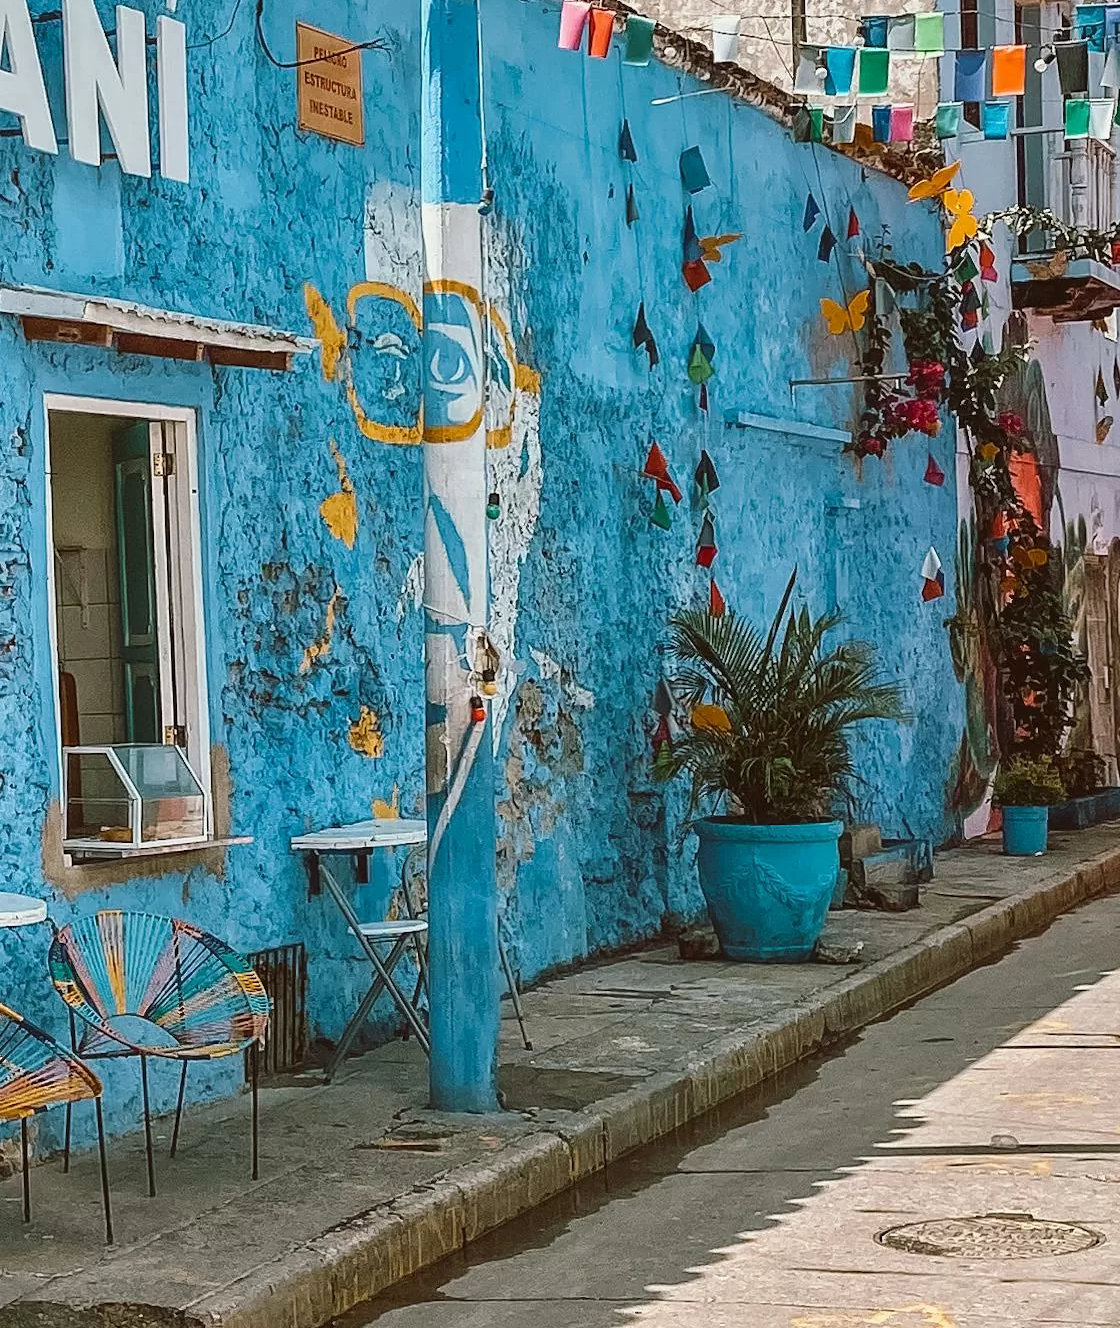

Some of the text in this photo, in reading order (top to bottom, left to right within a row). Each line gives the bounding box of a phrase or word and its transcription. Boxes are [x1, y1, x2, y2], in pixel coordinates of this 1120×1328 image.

[313, 46, 348, 69] PELIGRO
[304, 71, 357, 101] ESTRUCTURA
[308, 99, 354, 125] INESTABLE
